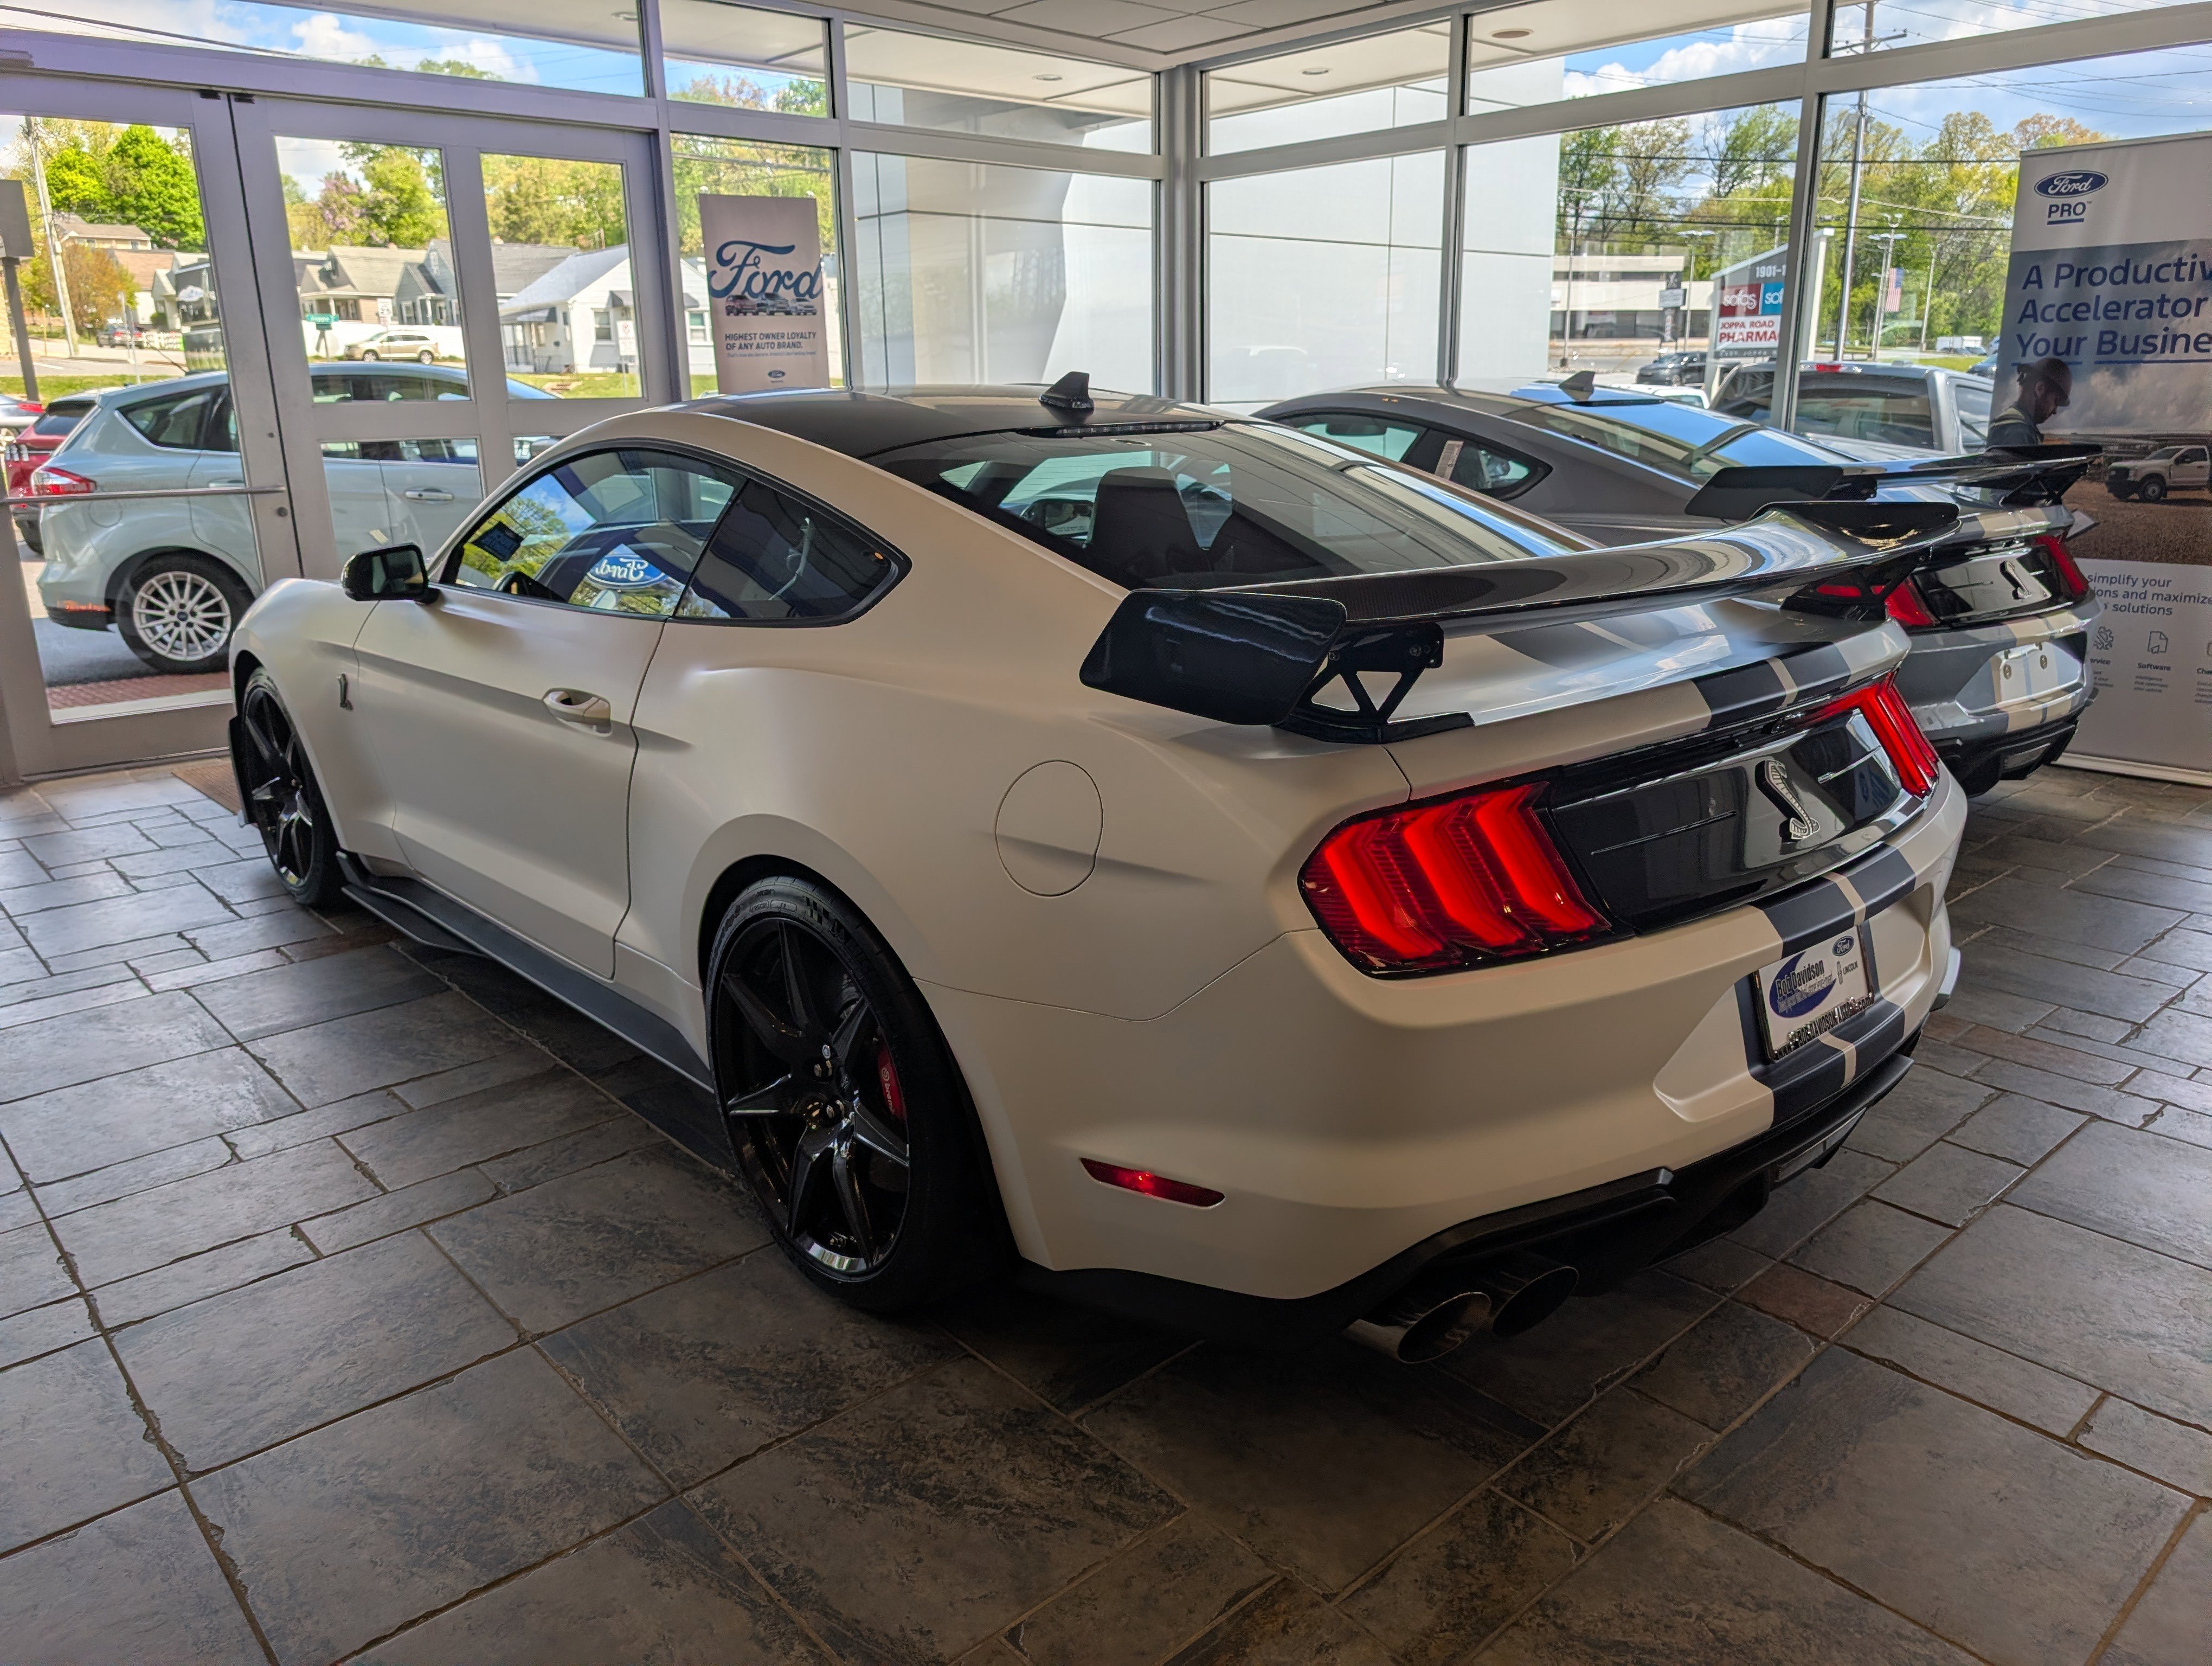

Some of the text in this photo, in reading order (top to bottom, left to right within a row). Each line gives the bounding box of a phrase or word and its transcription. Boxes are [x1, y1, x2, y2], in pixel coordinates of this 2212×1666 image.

[2048, 175, 2093, 194] Ford
[2047, 202, 2086, 219] PRO
[708, 240, 822, 298] Ford
[2022, 265, 2043, 290] A
[2017, 294, 2208, 324] Accelerator
[1721, 320, 1774, 329] JOPPA ROAD
[724, 331, 816, 341] HIGHEST OWNER LOYALTY
[1719, 330, 1777, 343] PHARMA
[2016, 326, 2212, 357] Your Busine
[725, 342, 736, 350] OF
[738, 342, 754, 350] ANY
[756, 342, 775, 350] AUTO
[2087, 573, 2172, 588] simplify your
[2122, 590, 2147, 600] and
[2112, 603, 2172, 616] solutions
[2137, 662, 2171, 671] Software
[1836, 939, 1850, 954] Ford
[1842, 961, 1859, 975] LINCOLN
[1776, 975, 1792, 997] Bob
[1791, 959, 1825, 991] Davidson
